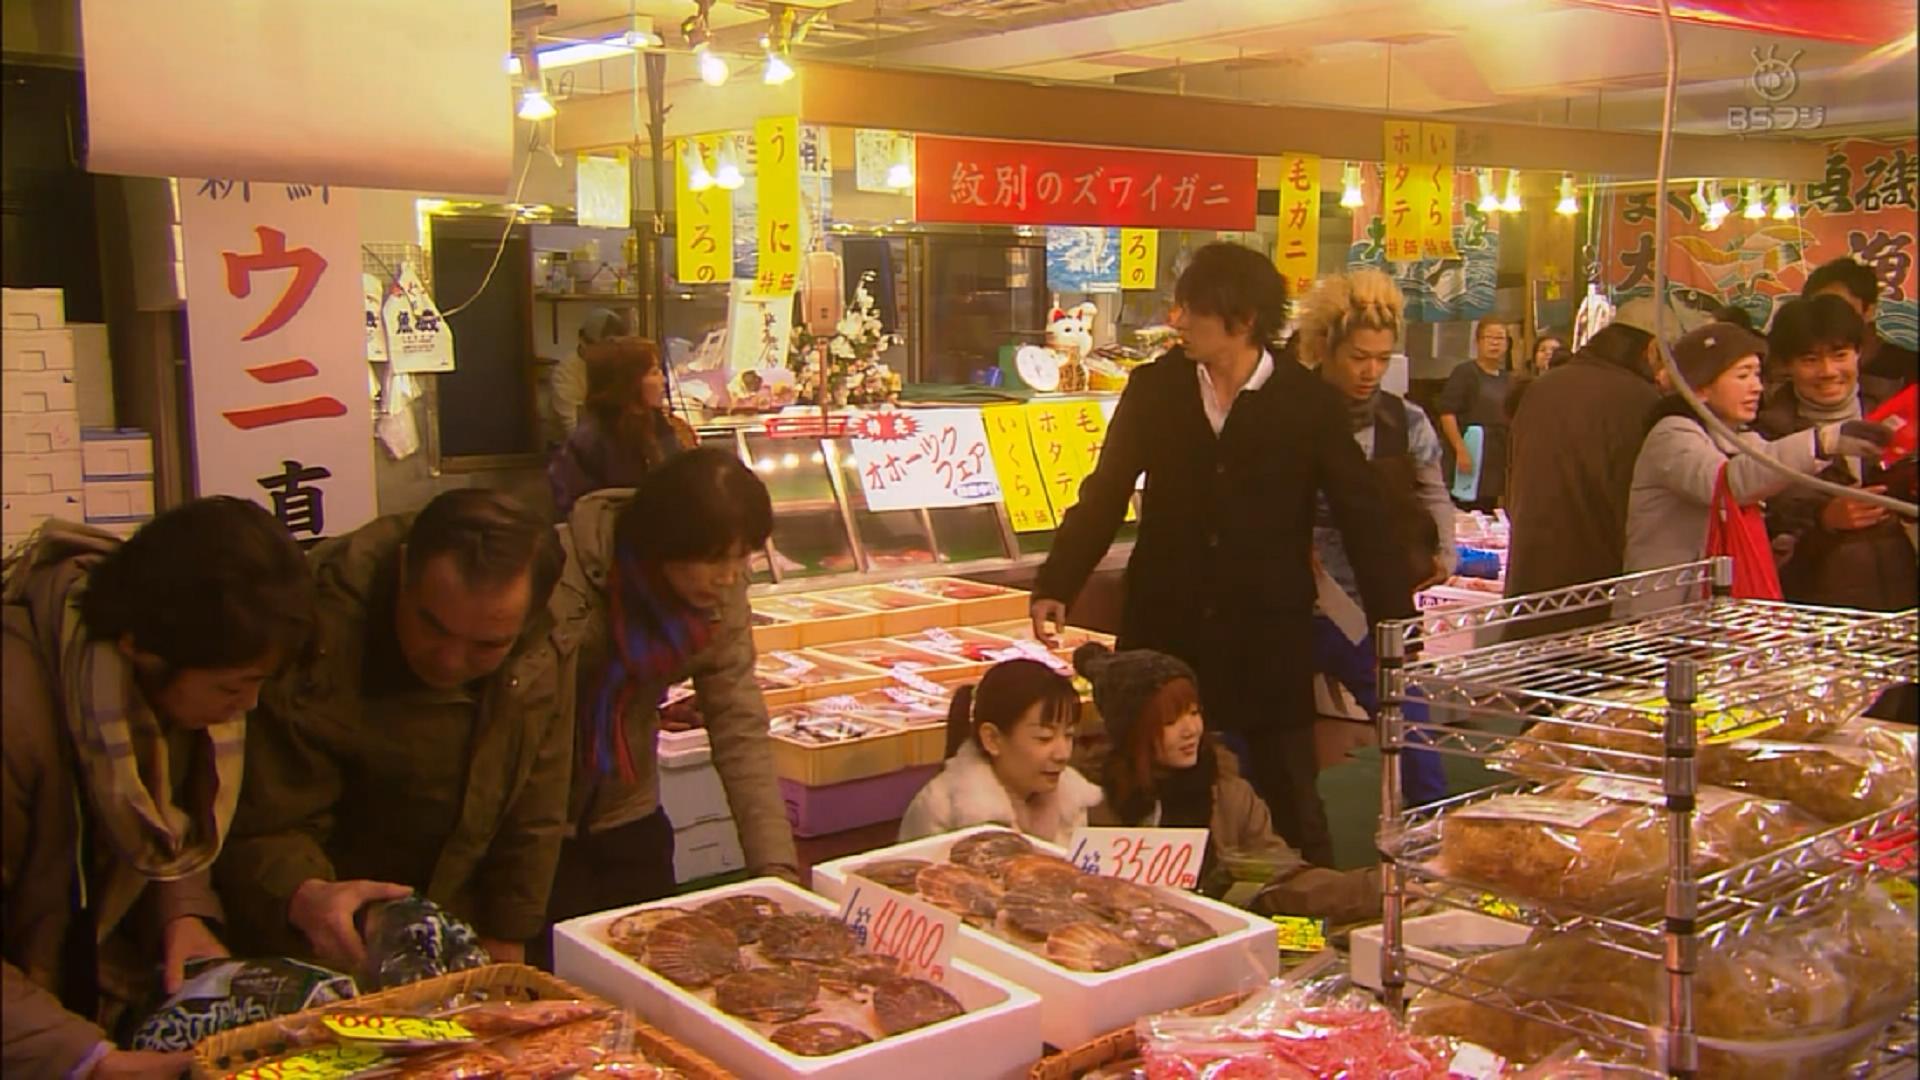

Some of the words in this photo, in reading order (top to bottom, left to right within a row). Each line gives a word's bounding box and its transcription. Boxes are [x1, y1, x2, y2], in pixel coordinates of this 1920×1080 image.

[768, 126, 793, 253] うに
[950, 161, 1232, 213] 紋別のズワイガニ
[1285, 158, 1312, 259] 毛ガニ
[1392, 128, 1411, 228] ホタテ
[1430, 132, 1448, 227] いくら
[222, 224, 348, 431] ウニ
[865, 426, 958, 490] オホーツク
[935, 441, 986, 489] フェア
[998, 416, 1031, 497] いくら
[1039, 411, 1073, 495] ホタテ
[1112, 834, 1196, 887] 3500円
[873, 898, 944, 981] 4000円
